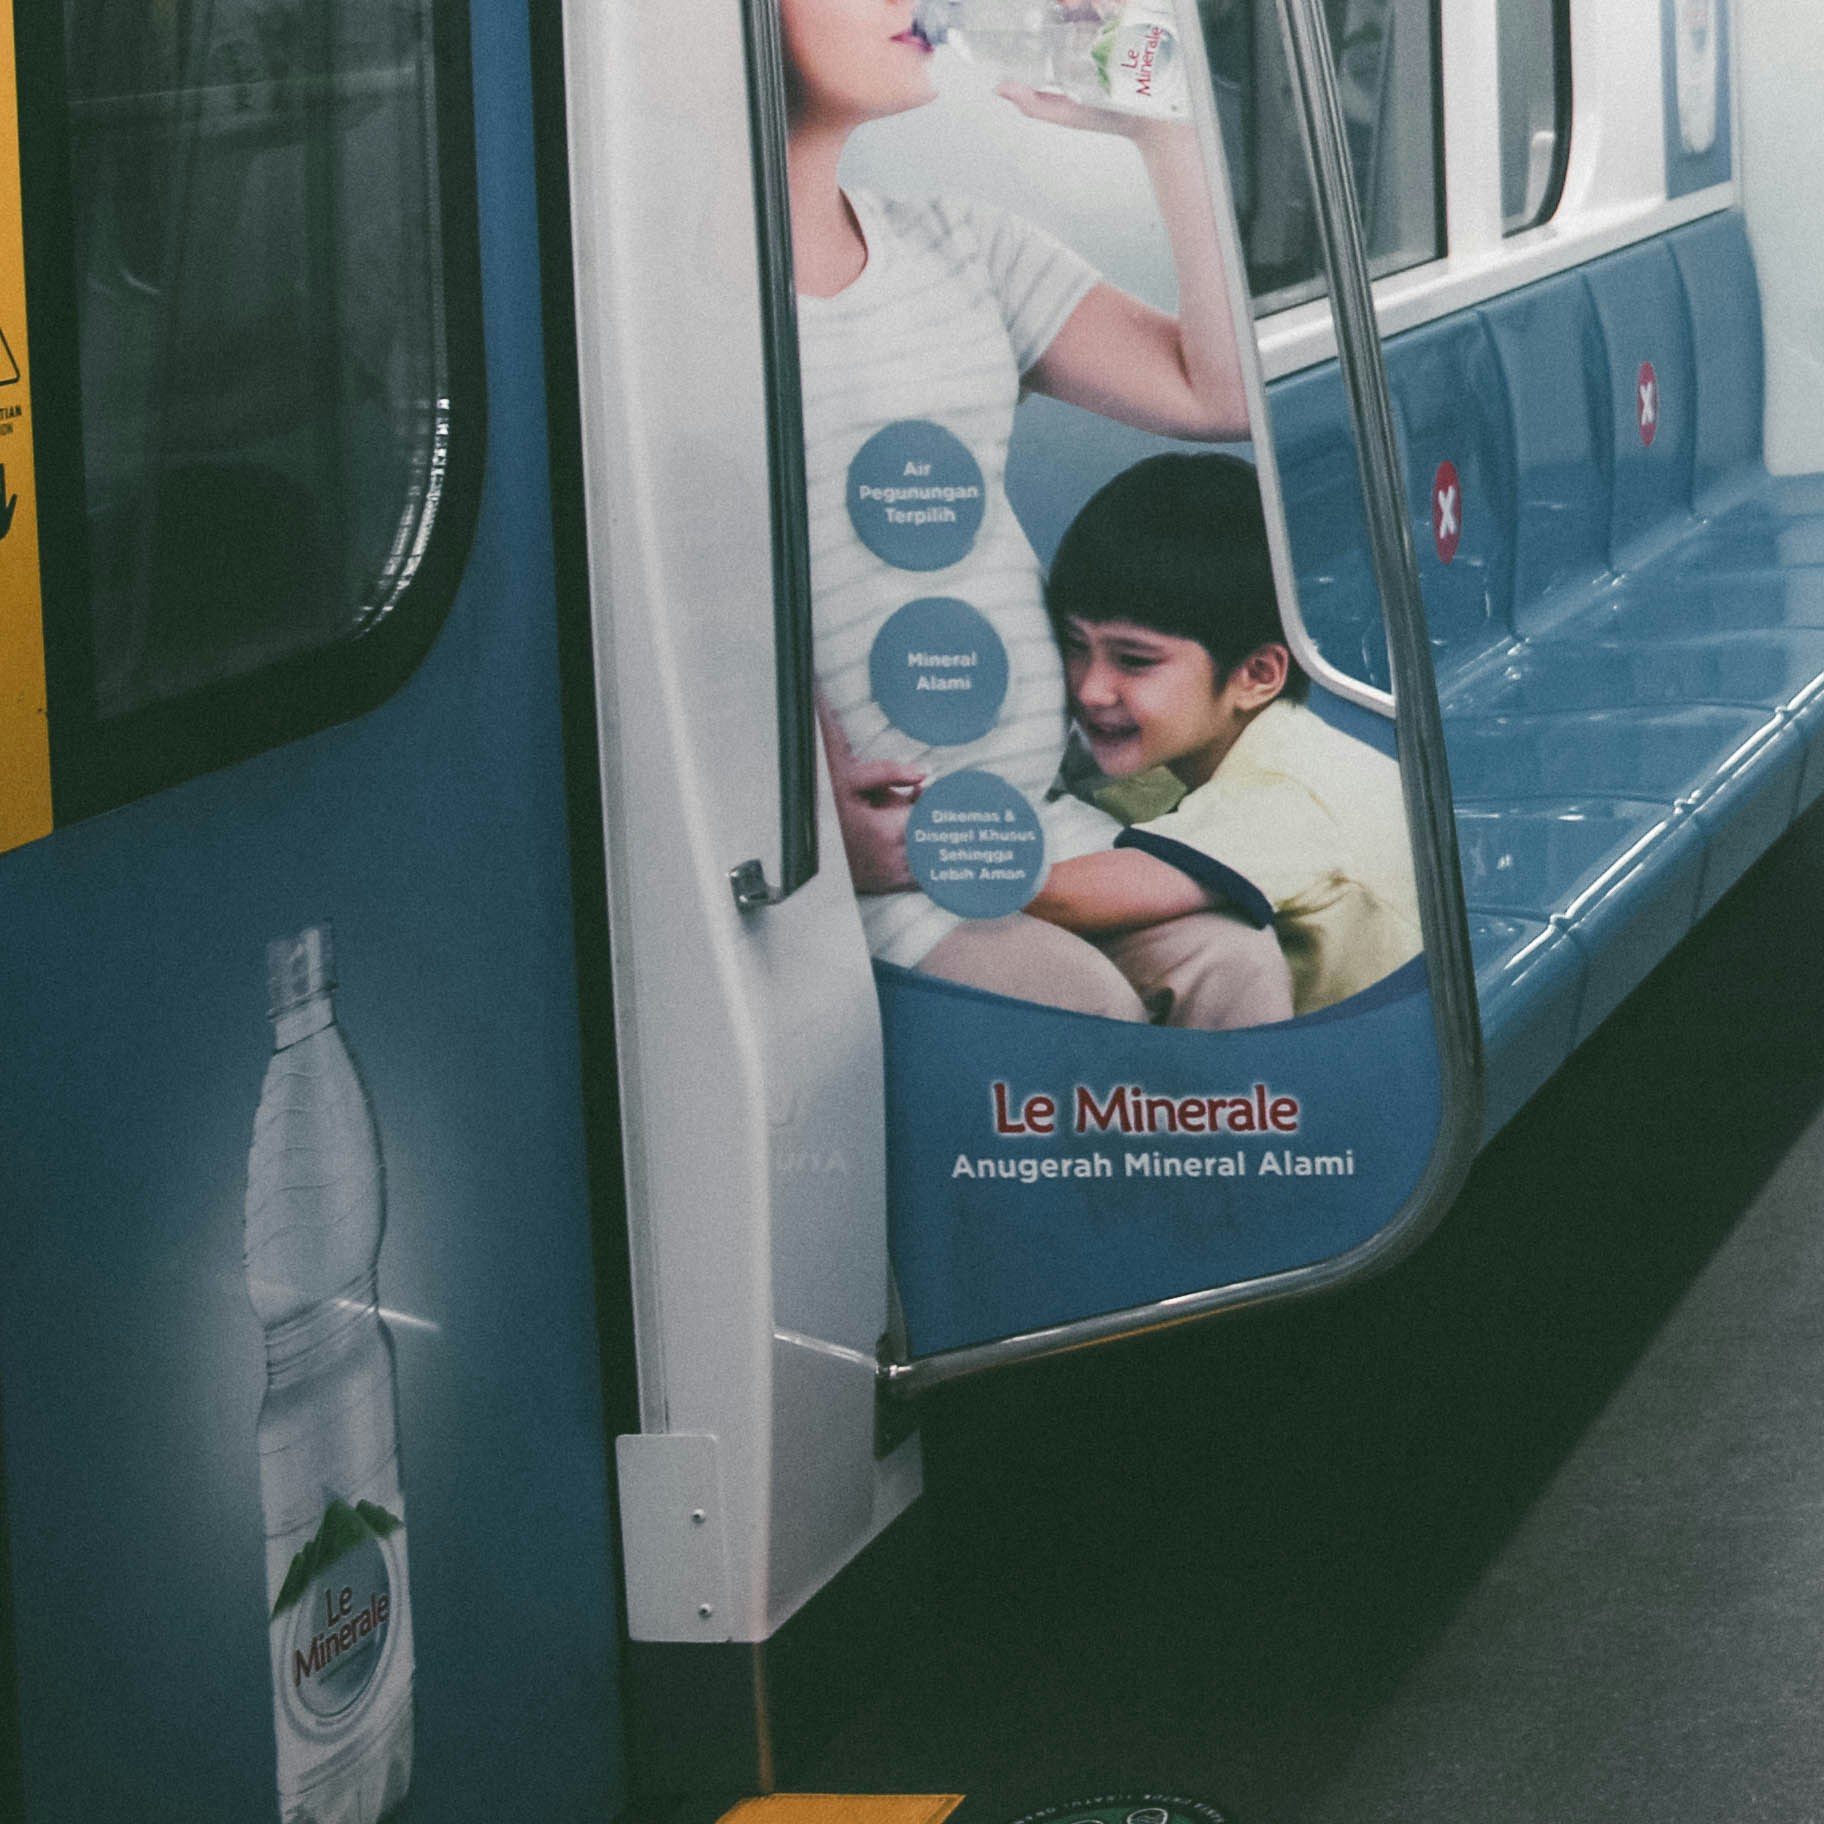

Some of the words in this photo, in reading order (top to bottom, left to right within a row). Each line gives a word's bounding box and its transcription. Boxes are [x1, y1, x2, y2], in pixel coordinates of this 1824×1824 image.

[1120, 49, 1140, 69] Le
[1136, 26, 1164, 96] Minerale
[904, 462, 931, 477] Air
[859, 485, 979, 503] Pegunungan
[885, 507, 956, 527] Terpilih
[908, 652, 977, 668] Mineral
[916, 675, 972, 691] Alami
[993, 1082, 1055, 1134] Le
[1076, 1083, 1299, 1134] Minerale
[952, 1152, 1112, 1184] Anugerah
[1125, 1151, 1245, 1178] Mineral
[1258, 1149, 1354, 1177] Alami
[325, 1586, 352, 1627] Le
[294, 1593, 391, 1688] Minerale
